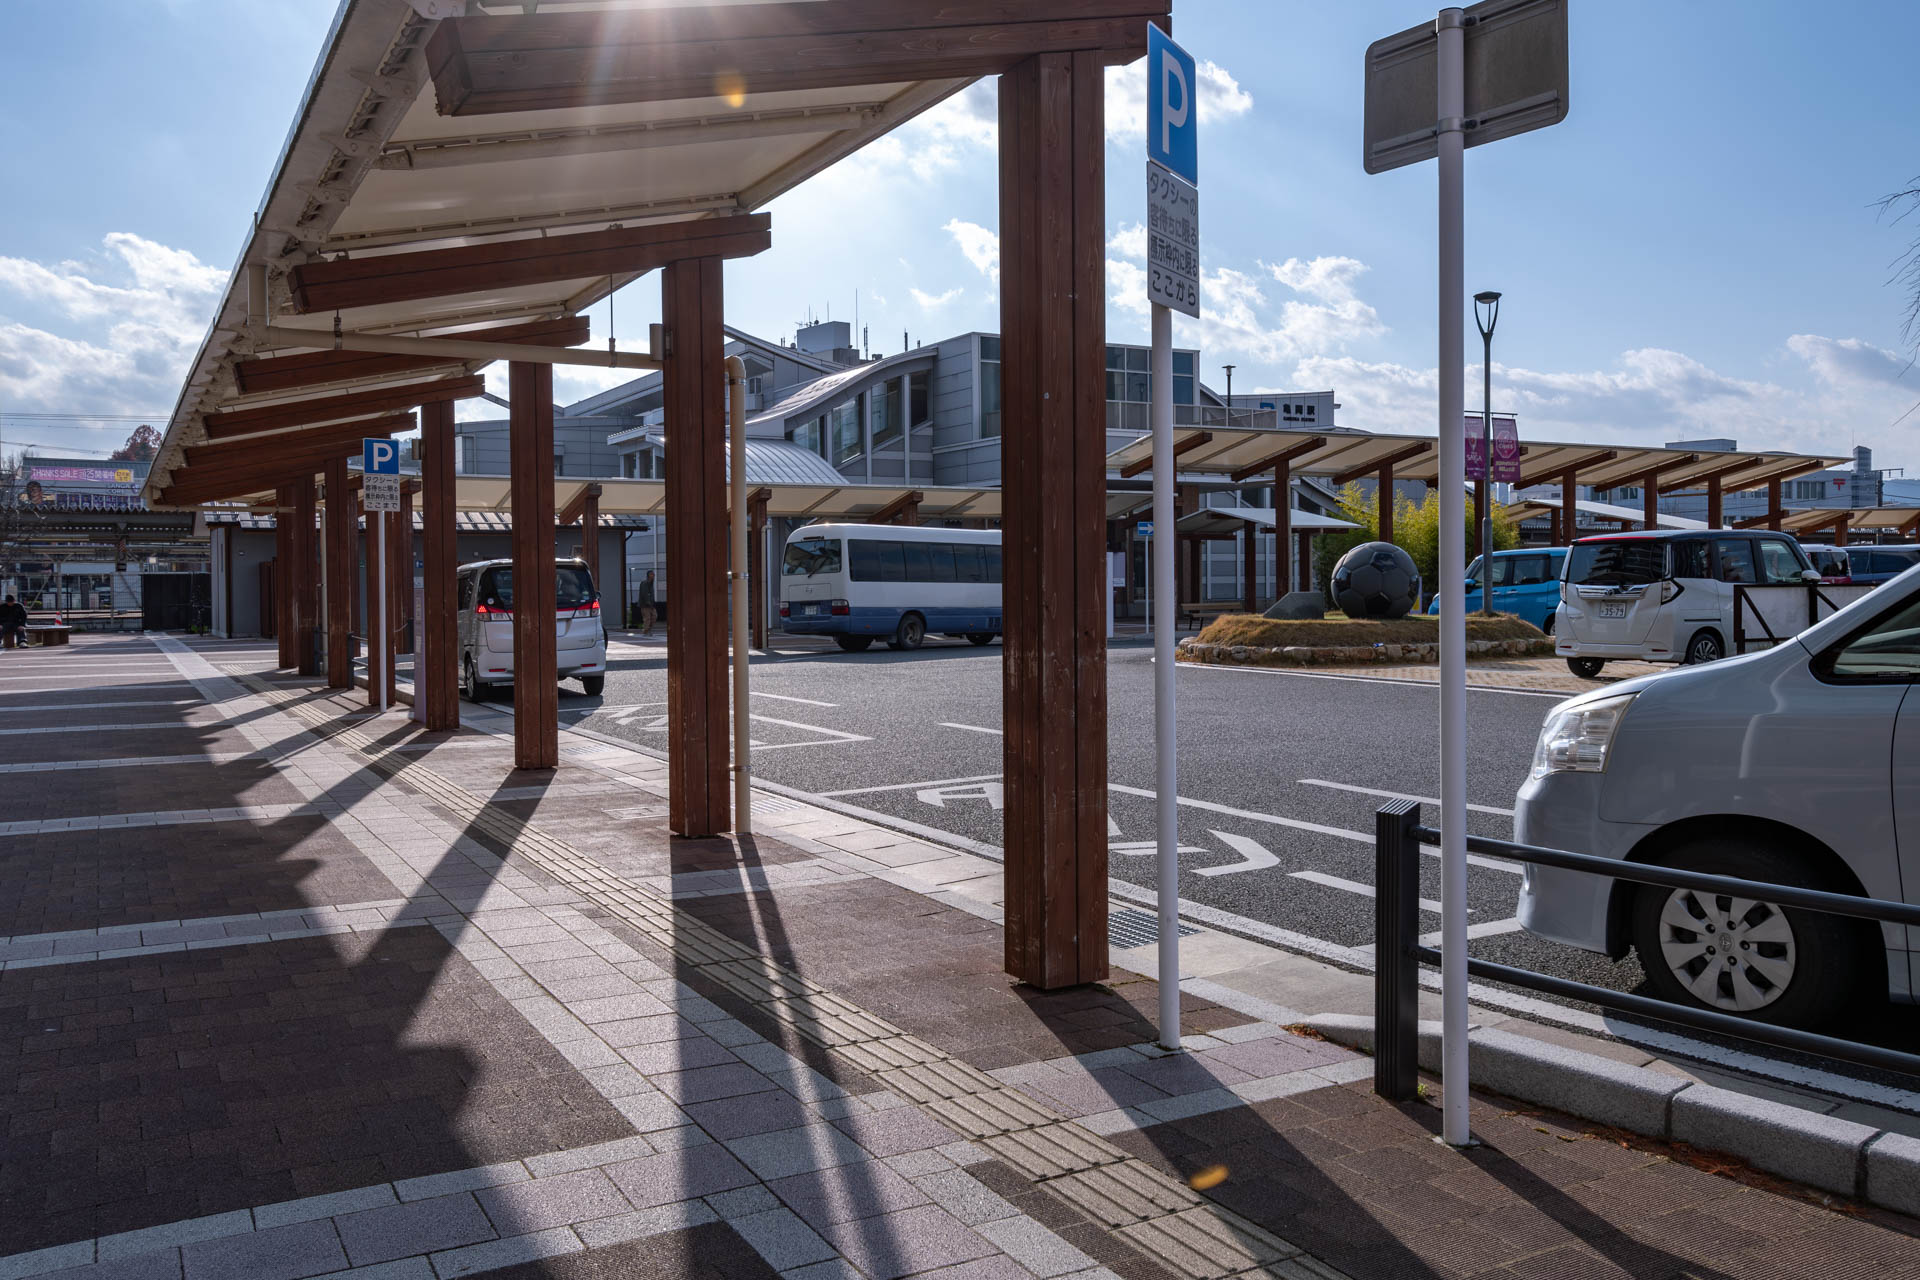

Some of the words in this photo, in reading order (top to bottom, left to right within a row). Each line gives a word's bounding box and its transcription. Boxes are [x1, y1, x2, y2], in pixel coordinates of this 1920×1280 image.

[1162, 47, 1188, 155] P
[1150, 172, 1196, 216] タクシーの
[1150, 202, 1197, 246] 客待ちに限る
[1152, 269, 1197, 307] ここから
[373, 442, 393, 471] P
[365, 476, 399, 484] タクシーの
[366, 501, 398, 509] ここまで
